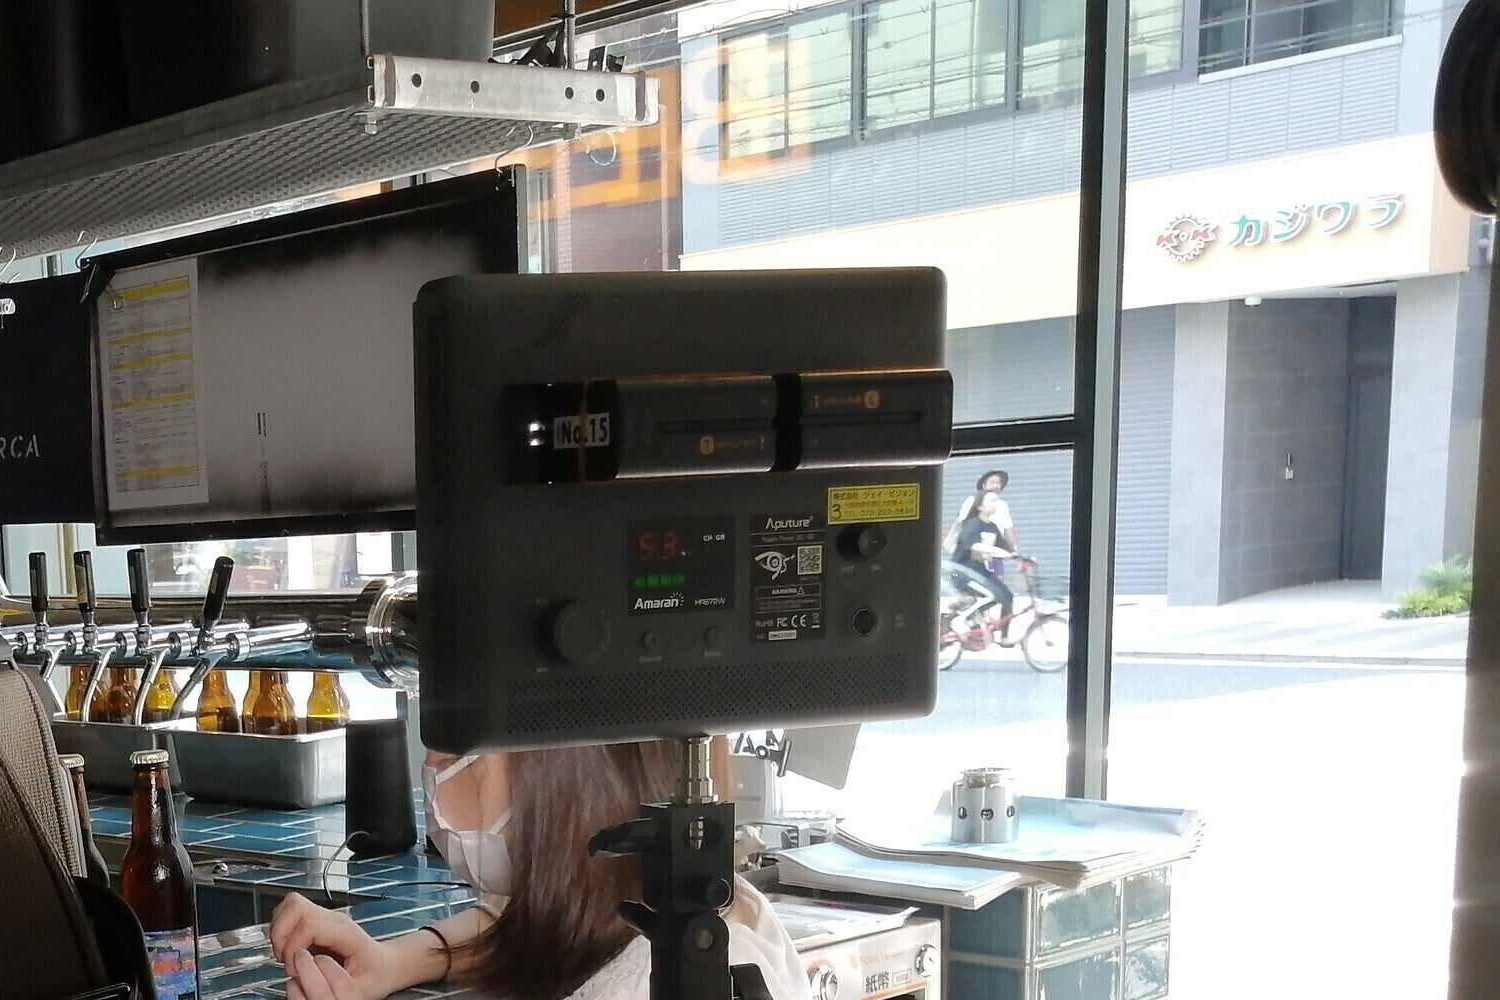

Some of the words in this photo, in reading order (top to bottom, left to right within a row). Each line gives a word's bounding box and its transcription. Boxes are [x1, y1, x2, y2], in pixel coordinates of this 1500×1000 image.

[1227, 193, 1404, 248] カジワラ
[561, 417, 608, 444] No.15
[831, 503, 842, 519] 3
[765, 517, 810, 531] Aputure
[634, 597, 679, 610] Amaran
